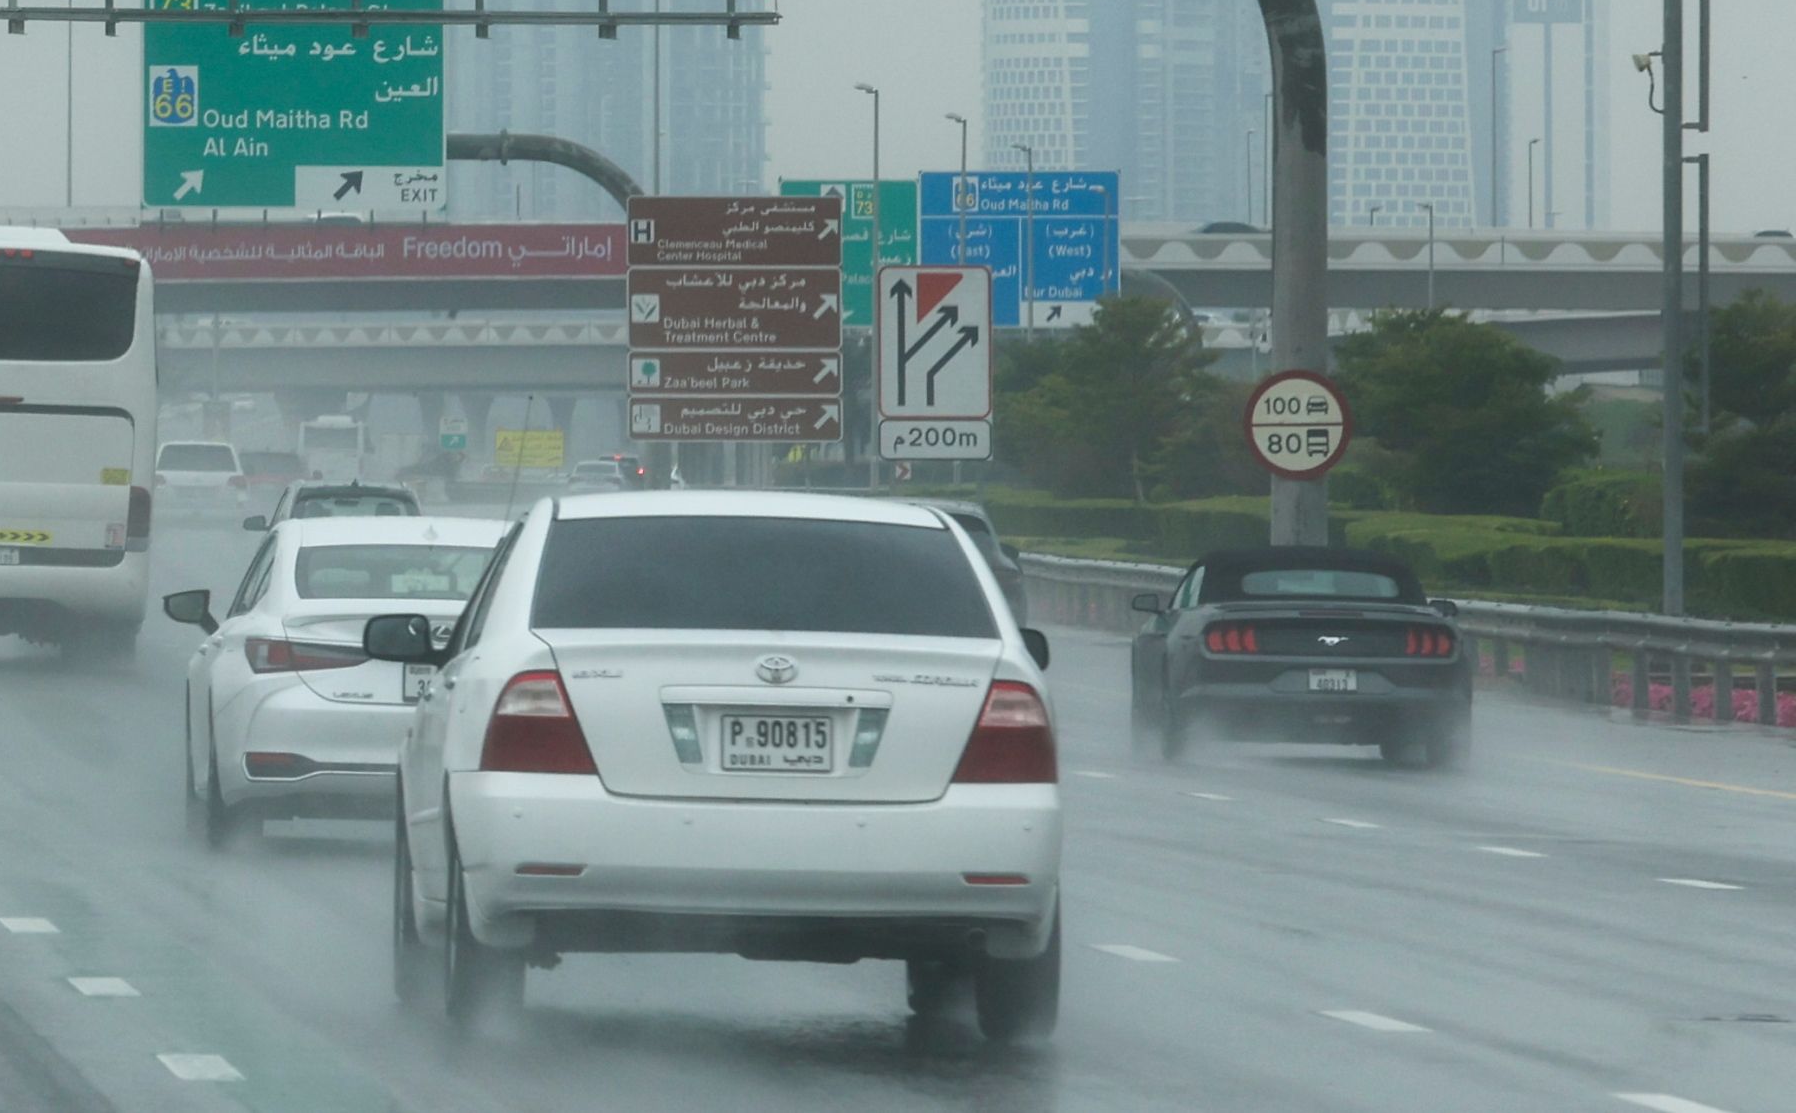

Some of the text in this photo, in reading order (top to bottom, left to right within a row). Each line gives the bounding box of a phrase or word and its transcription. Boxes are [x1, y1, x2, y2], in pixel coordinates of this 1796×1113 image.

[238, 34, 438, 62] شارع عود ميثاء
[375, 77, 438, 102] العين
[155, 95, 193, 118] 66
[204, 110, 369, 129] Oud Maitha Rd
[204, 139, 268, 156] Al Ain
[394, 170, 438, 185] مخرج
[401, 189, 437, 202] EXIT
[855, 201, 873, 214] 73
[981, 198, 1069, 210] Oud Matha Rd
[403, 237, 502, 258] Freedom
[508, 236, 612, 267] إماراتي
[657, 239, 767, 249] Clemenceau Medical
[1048, 244, 1091, 259] (West)
[657, 250, 742, 262] Center Hospital
[1048, 286, 1083, 298] Dubai
[664, 317, 700, 329] Dubai
[704, 317, 747, 329] Herbal
[664, 331, 777, 343] Treatment Centre
[721, 377, 750, 389] Park
[1264, 397, 1301, 415] 100
[663, 422, 800, 436] Dubai Design District
[1268, 433, 1302, 454] 80
[730, 719, 827, 749] P 90815
[730, 754, 771, 766] DUBAI
